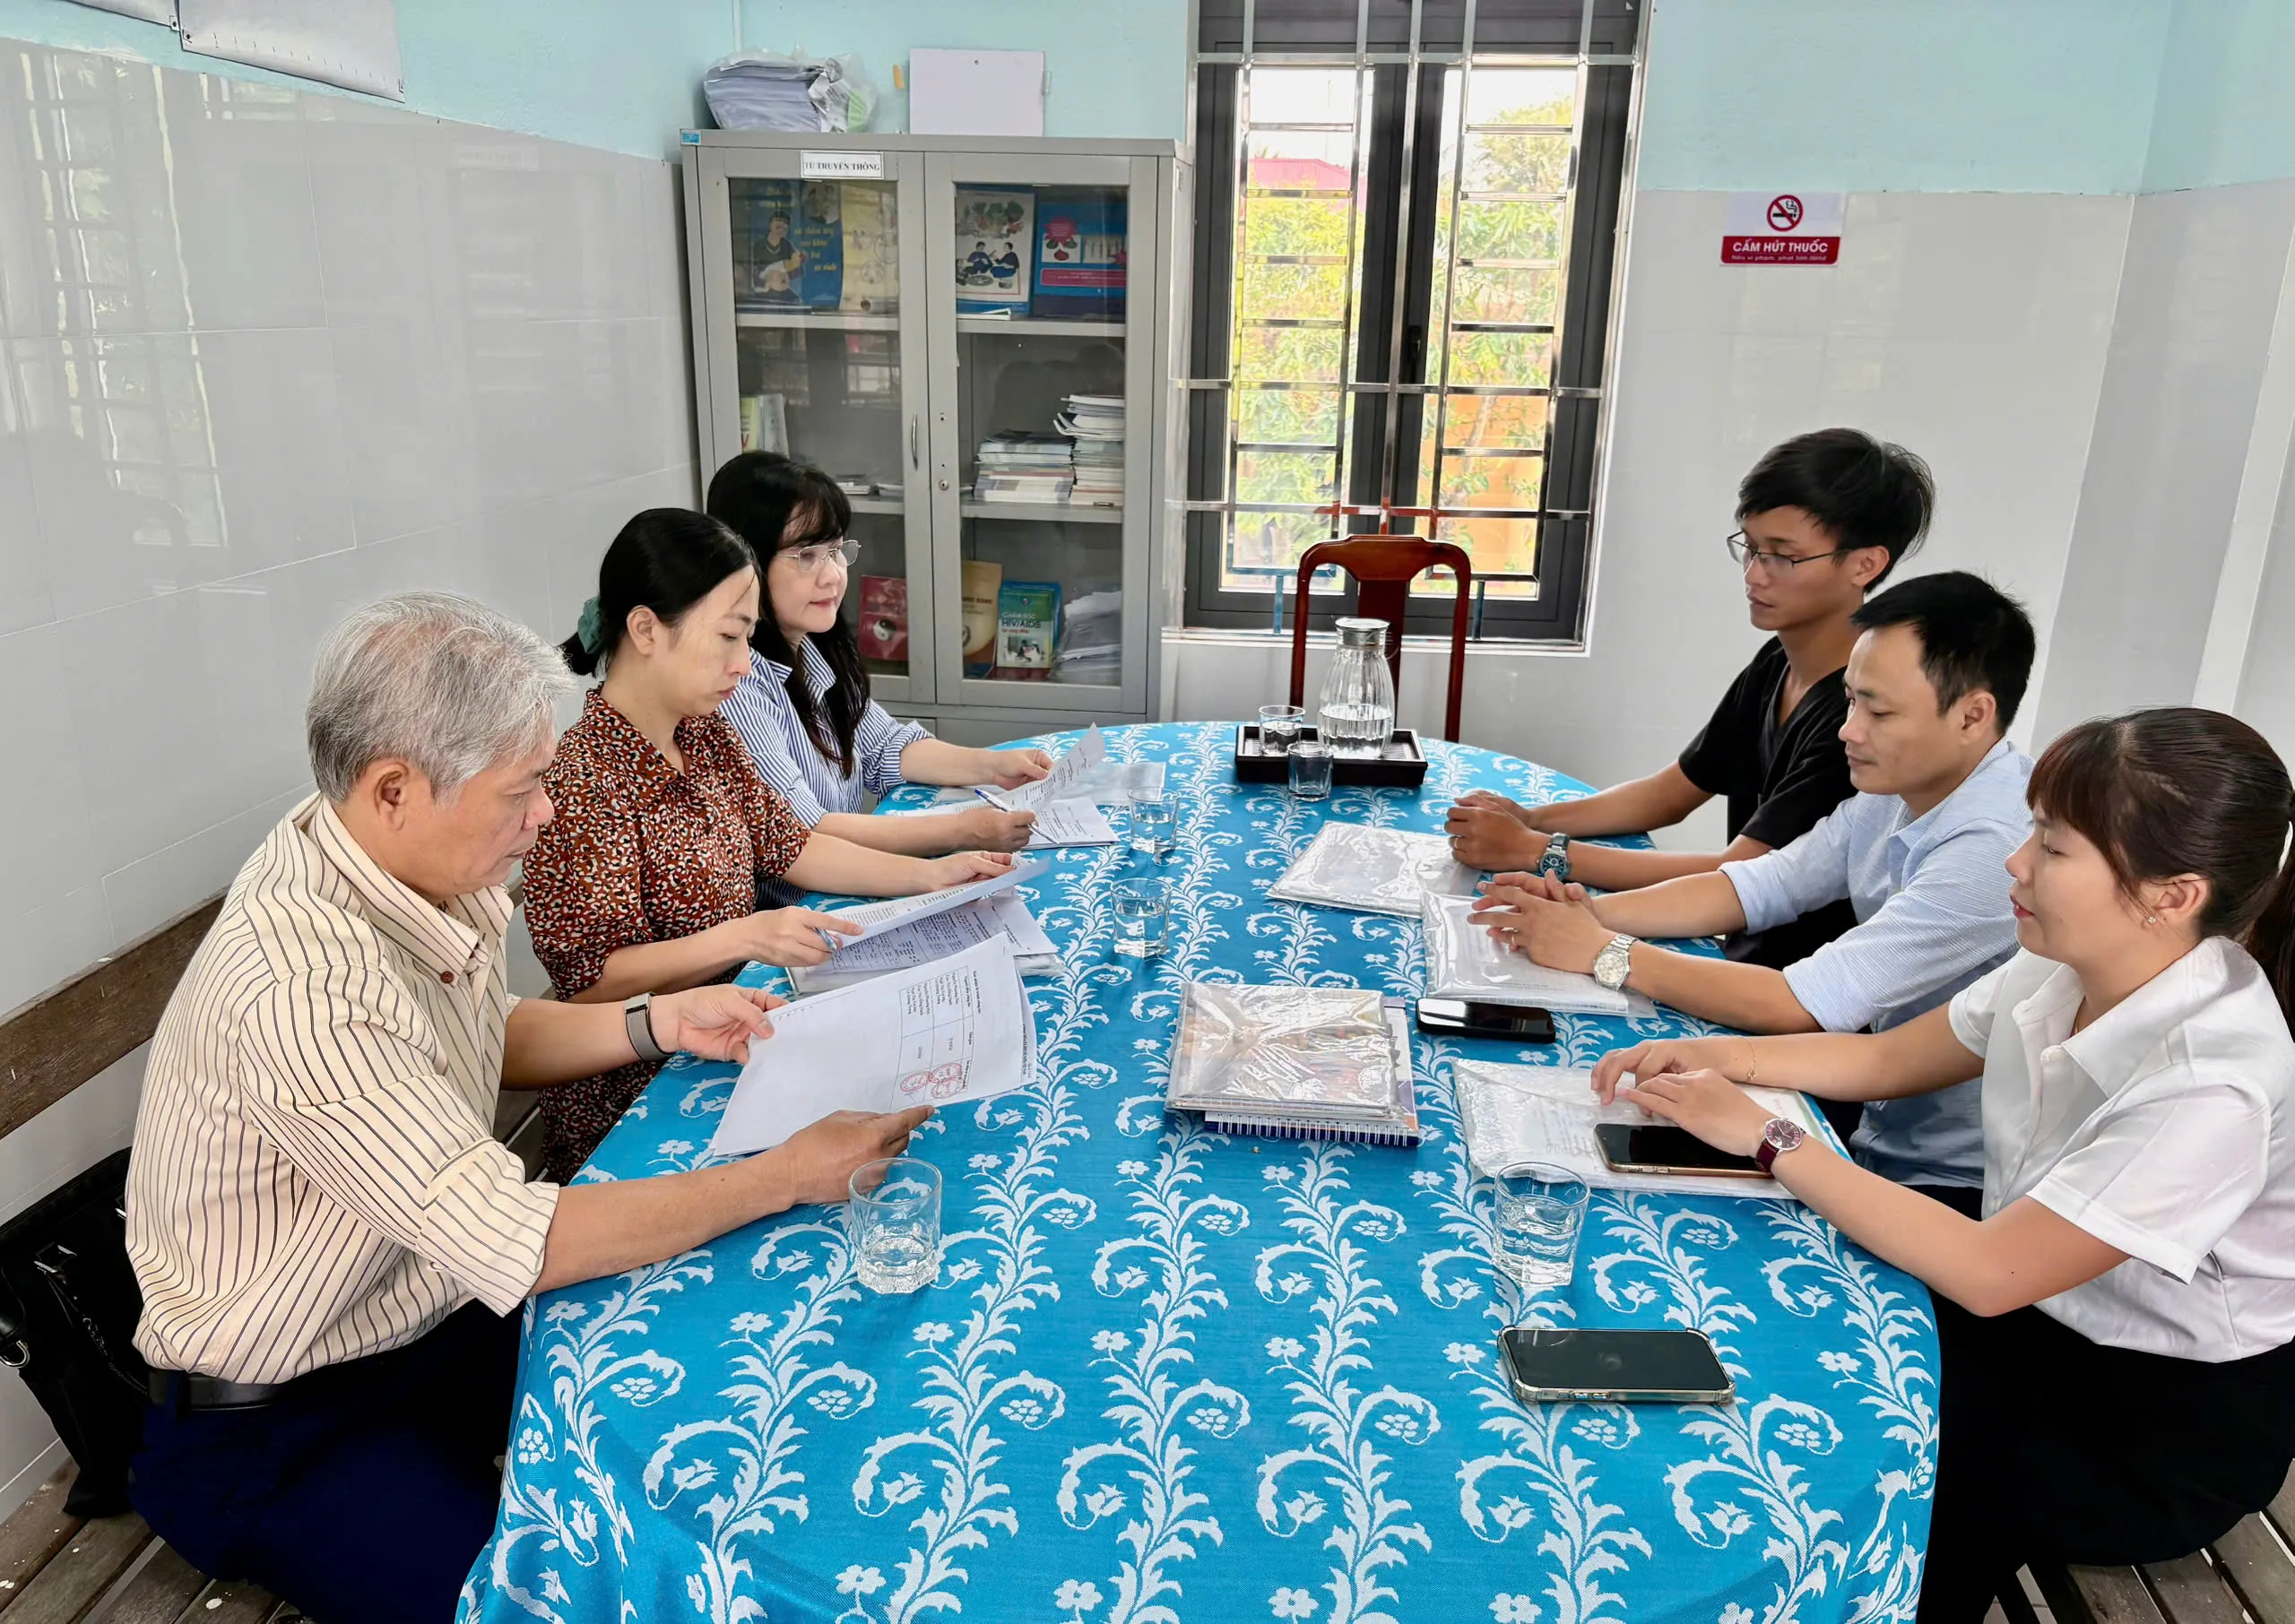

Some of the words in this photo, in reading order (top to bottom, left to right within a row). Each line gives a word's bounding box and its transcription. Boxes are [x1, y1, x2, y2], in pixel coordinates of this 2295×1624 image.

[852, 161, 880, 171] THÔNG
[1732, 238, 1762, 252] CẤM
[1763, 239, 1787, 253] HÚT
[1788, 238, 1829, 253] THUỐC
[1001, 619, 1041, 628] HIV/AIDS
